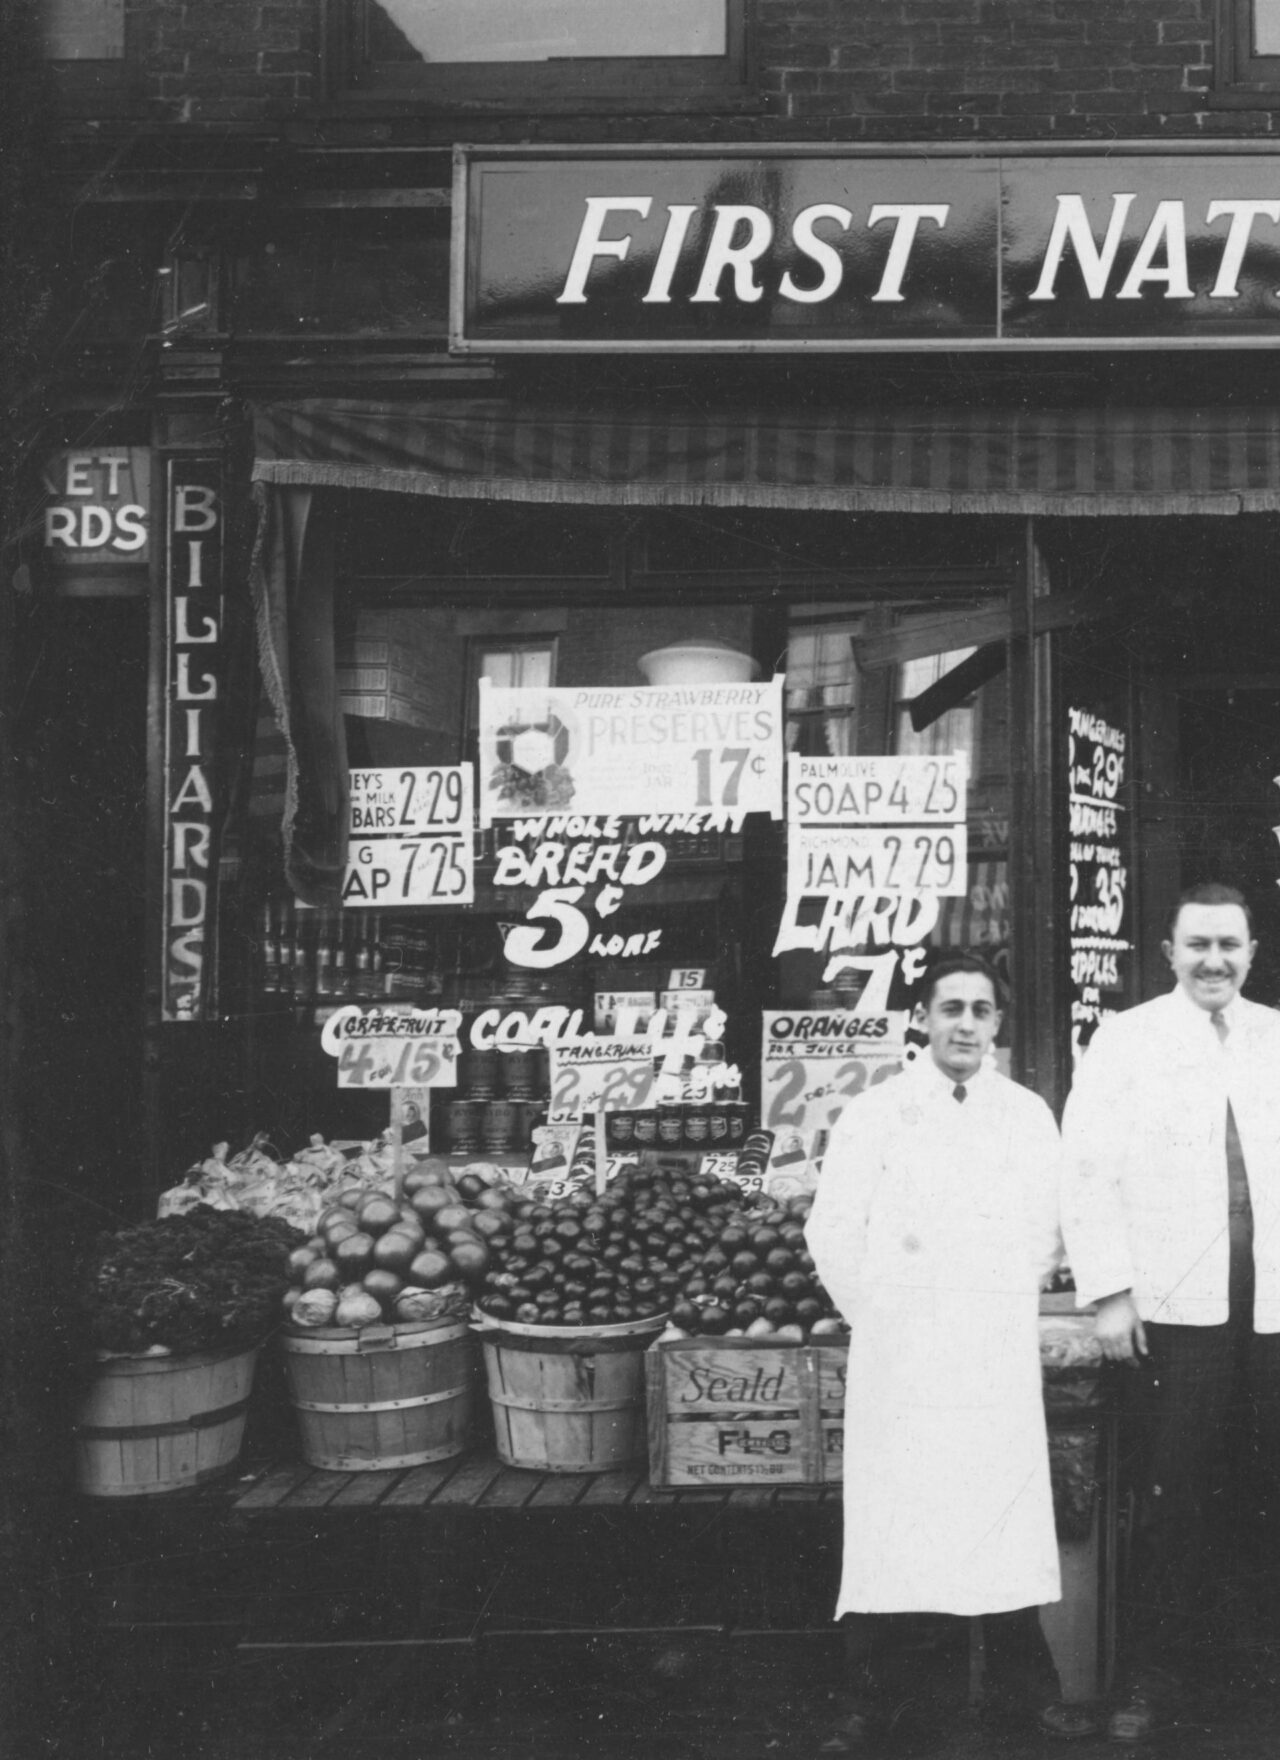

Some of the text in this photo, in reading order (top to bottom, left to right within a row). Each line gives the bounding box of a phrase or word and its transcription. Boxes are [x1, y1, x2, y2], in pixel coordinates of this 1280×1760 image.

[556, 195, 950, 303] FIRST
[572, 688, 768, 709] PURE STRAWBERRY
[169, 485, 218, 986] BILLIARDS
[588, 709, 773, 757] PRESERVES
[794, 782, 883, 816] SOAP
[922, 761, 958, 814] 25
[800, 762, 876, 778] PALMOLIVE
[352, 806, 396, 828] BARS
[426, 770, 463, 825] 29
[513, 815, 623, 842] WHOLE
[637, 811, 748, 835] WHEAT
[429, 841, 468, 897] 25
[493, 841, 667, 887] BREAD
[804, 852, 875, 889] JAM
[882, 835, 902, 889] 2
[914, 835, 956, 889] 29
[588, 929, 663, 958] LOAF
[771, 894, 941, 958] LARD
[678, 970, 699, 988] 15
[344, 1016, 447, 1035] GRAPEFRUIT
[770, 1014, 889, 1039] ORANGES
[340, 1043, 374, 1084] 4
[556, 1043, 652, 1059] TANGERINES
[768, 1043, 855, 1055] FOR JUICE
[767, 1060, 807, 1128] 2
[681, 1366, 785, 1404] Seald
